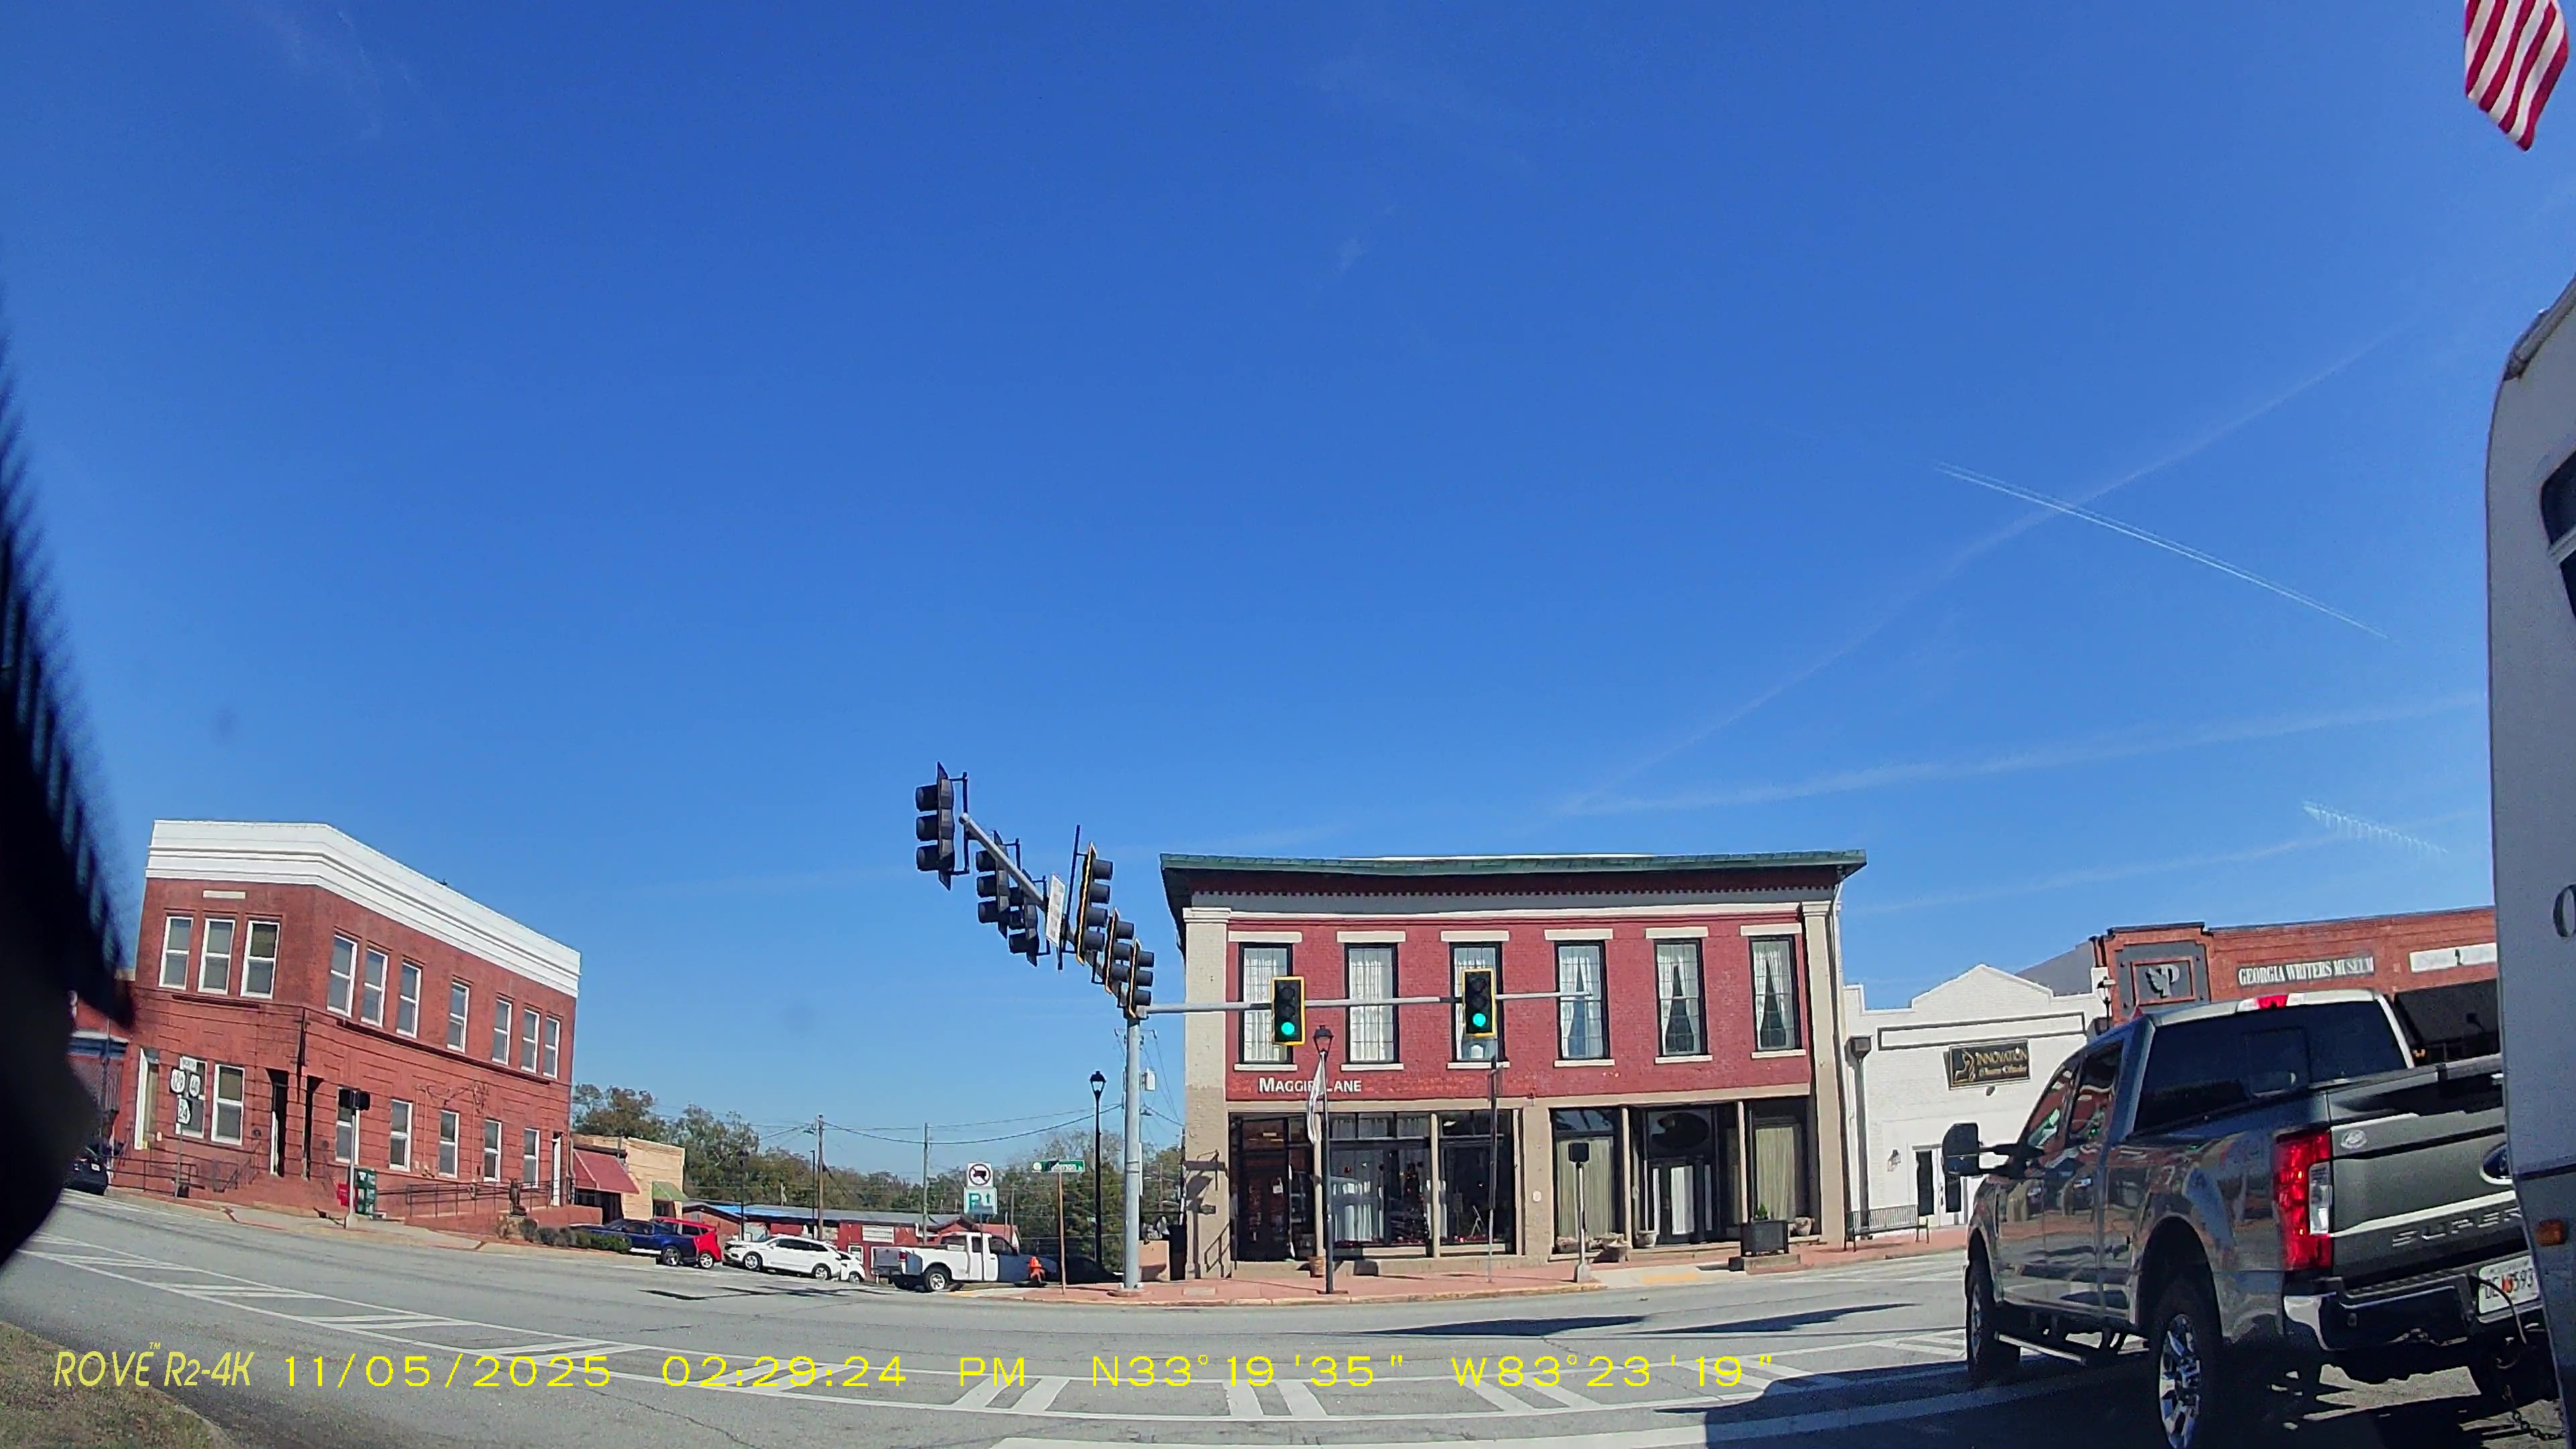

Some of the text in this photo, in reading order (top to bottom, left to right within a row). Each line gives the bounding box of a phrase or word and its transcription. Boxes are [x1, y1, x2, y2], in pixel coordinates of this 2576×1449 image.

[2239, 965, 2286, 985] GEORGIA
[178, 1105, 189, 1120] 24
[969, 1193, 982, 1210] P
[2392, 1207, 2523, 1248] SUPER
